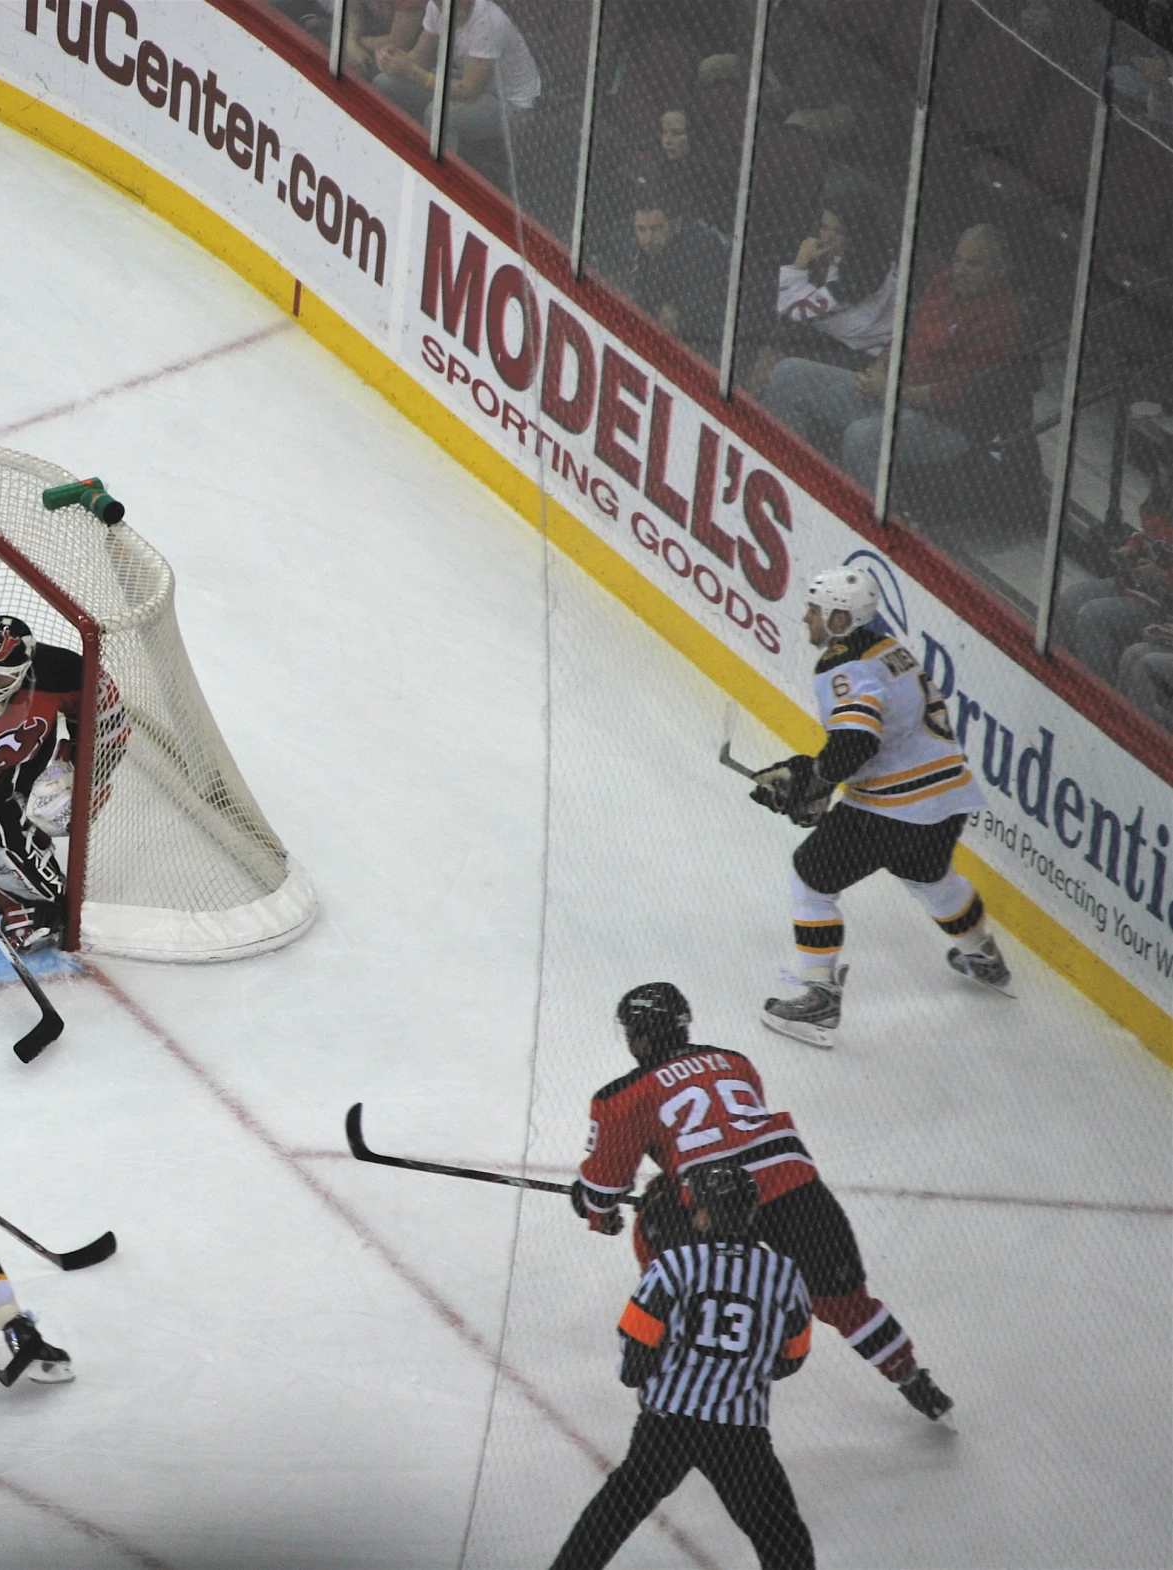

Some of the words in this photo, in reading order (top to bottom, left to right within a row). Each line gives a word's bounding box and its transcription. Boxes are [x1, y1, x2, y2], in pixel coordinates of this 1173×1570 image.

[420, 200, 793, 602] MODELL'S
[421, 335, 619, 520] SPORTING
[630, 513, 781, 655] GOODS
[831, 673, 851, 698] 6
[921, 630, 1173, 930] Prudenti
[985, 811, 1017, 851] and
[1021, 833, 1107, 932] Protecting
[1113, 906, 1152, 960] Your
[655, 1053, 733, 1088] ODUYA
[659, 1079, 769, 1152] 29
[696, 1299, 753, 1352] 13
